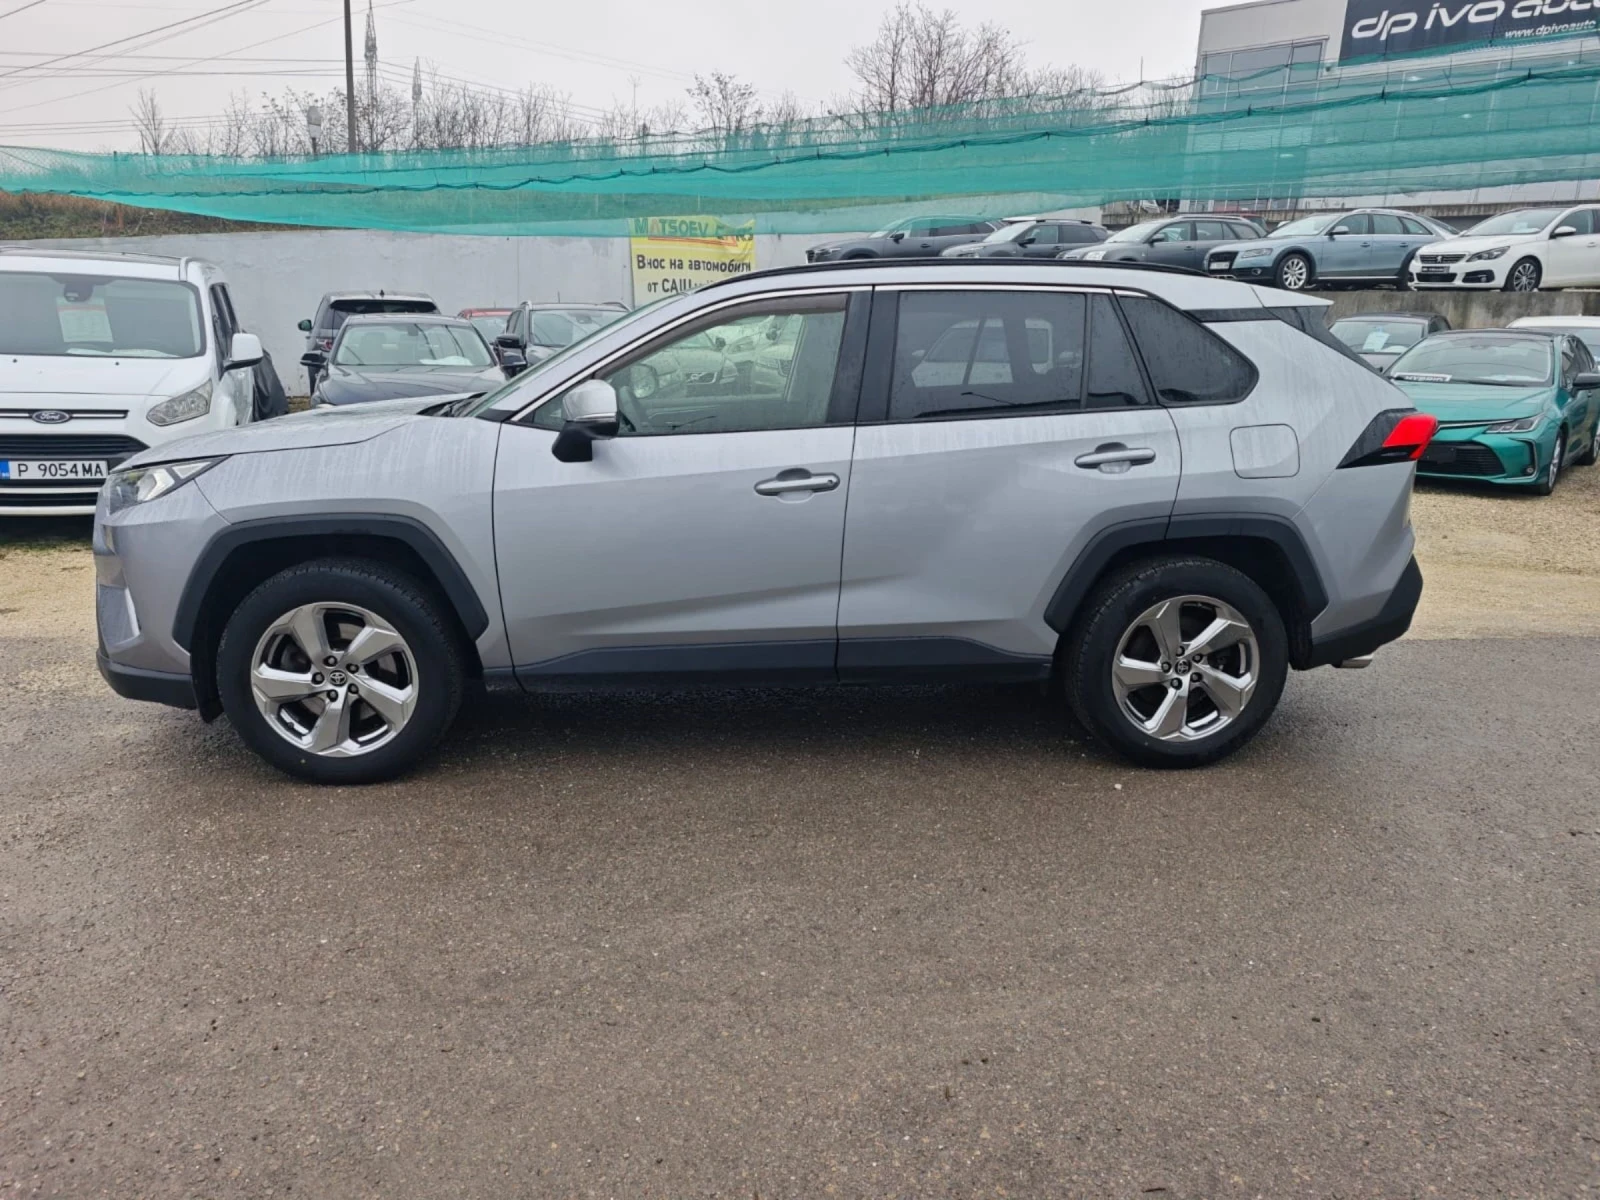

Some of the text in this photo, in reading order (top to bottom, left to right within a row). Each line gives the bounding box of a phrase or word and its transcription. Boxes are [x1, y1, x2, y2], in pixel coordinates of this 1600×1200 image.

[1351, 0, 1600, 40] dp ivo au
[634, 218, 708, 237] MATSOEV
[669, 258, 683, 269] на
[647, 282, 658, 293] от
[38, 463, 79, 477] 9054
